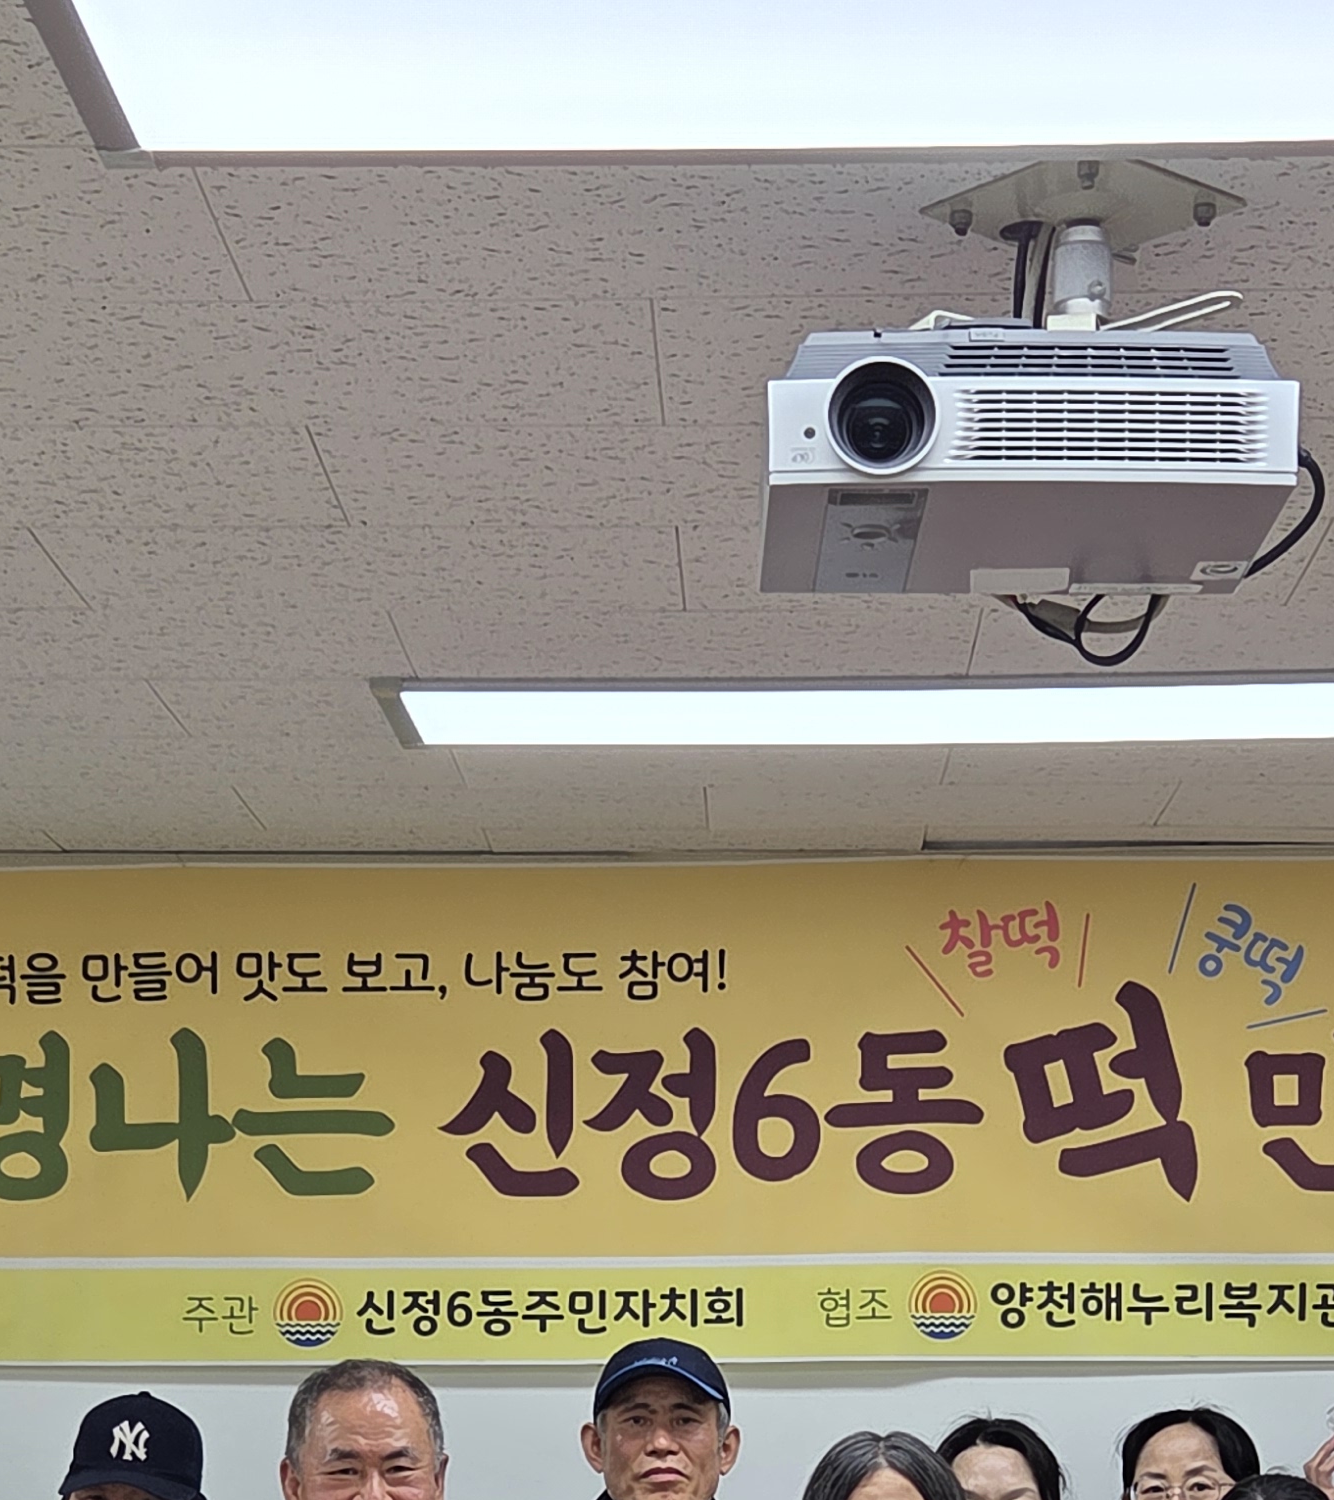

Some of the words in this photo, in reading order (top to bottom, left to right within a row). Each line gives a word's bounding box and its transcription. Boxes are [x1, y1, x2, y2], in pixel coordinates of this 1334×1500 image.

[938, 900, 1060, 978] 찰떡
[1198, 903, 1304, 1006] 쿵떡
[81, 951, 218, 1002] 만들어
[235, 950, 329, 1002] 맛도
[342, 951, 448, 1000] 보고,
[463, 950, 604, 1001] 나눔도
[619, 948, 727, 1000] 참여!
[438, 1027, 985, 1200] 신정6동
[1003, 980, 1199, 1202] 떡
[182, 1295, 259, 1335] 주관
[356, 1286, 745, 1337] 신정6동주민자치회
[817, 1286, 893, 1328] 협조
[110, 1420, 150, 1461] NY
